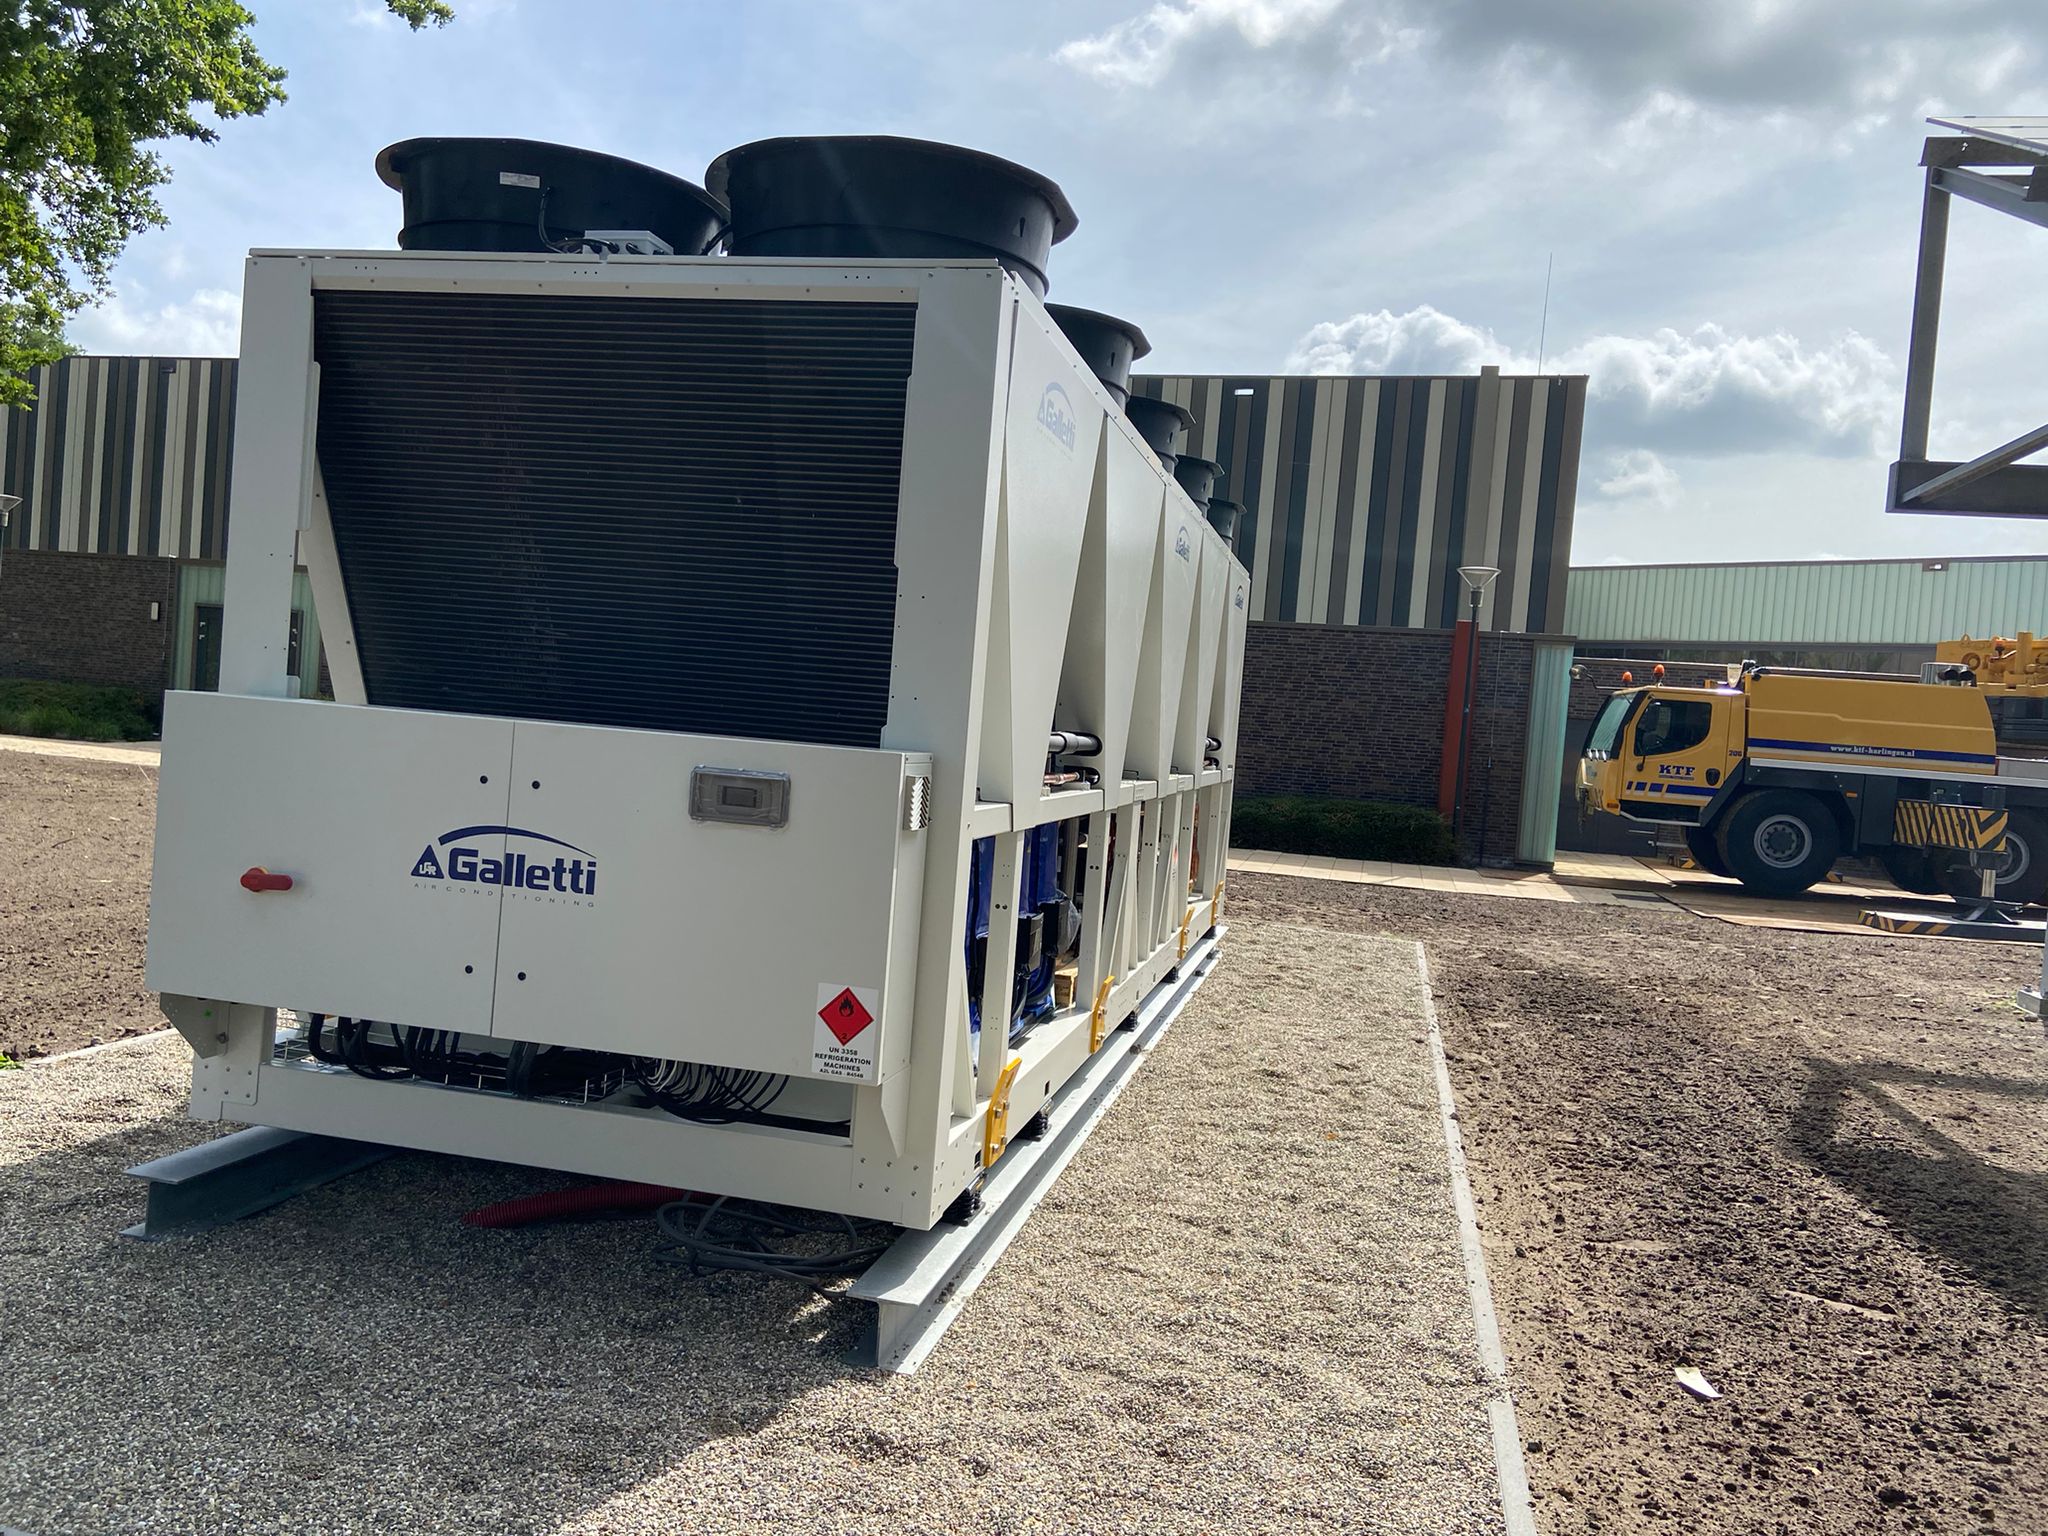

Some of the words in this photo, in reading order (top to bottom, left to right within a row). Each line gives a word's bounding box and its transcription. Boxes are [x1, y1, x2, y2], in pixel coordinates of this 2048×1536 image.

[1045, 398, 1076, 453] Galletti
[1659, 764, 1696, 776] KTF
[448, 847, 597, 896] Galletti
[815, 1053, 871, 1065] REFRIGERATION
[824, 1062, 861, 1072] MACHINES
